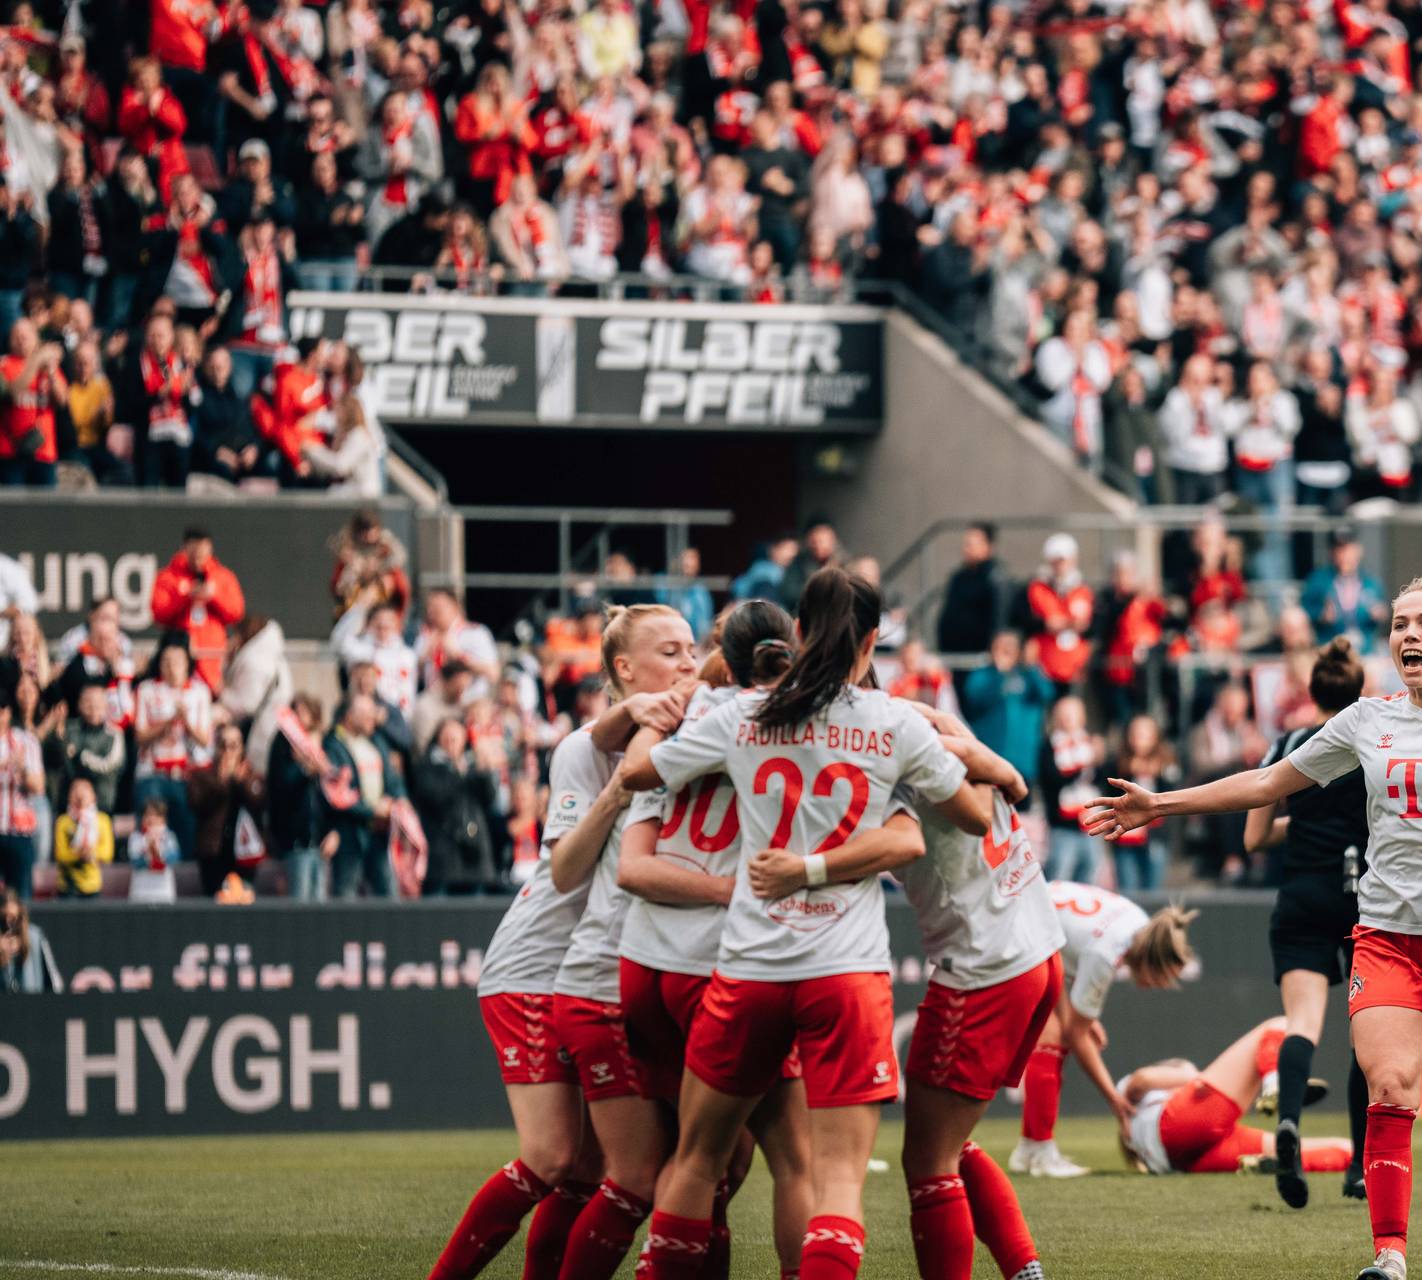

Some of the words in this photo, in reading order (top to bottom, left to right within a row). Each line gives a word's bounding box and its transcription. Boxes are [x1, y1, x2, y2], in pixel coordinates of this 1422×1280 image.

[596, 318, 841, 371] SILBER
[640, 372, 824, 425] PFEIL
[736, 720, 895, 757] PADILLA-BIDAS
[753, 757, 870, 854] 22
[65, 1013, 392, 1116] HYGH.
